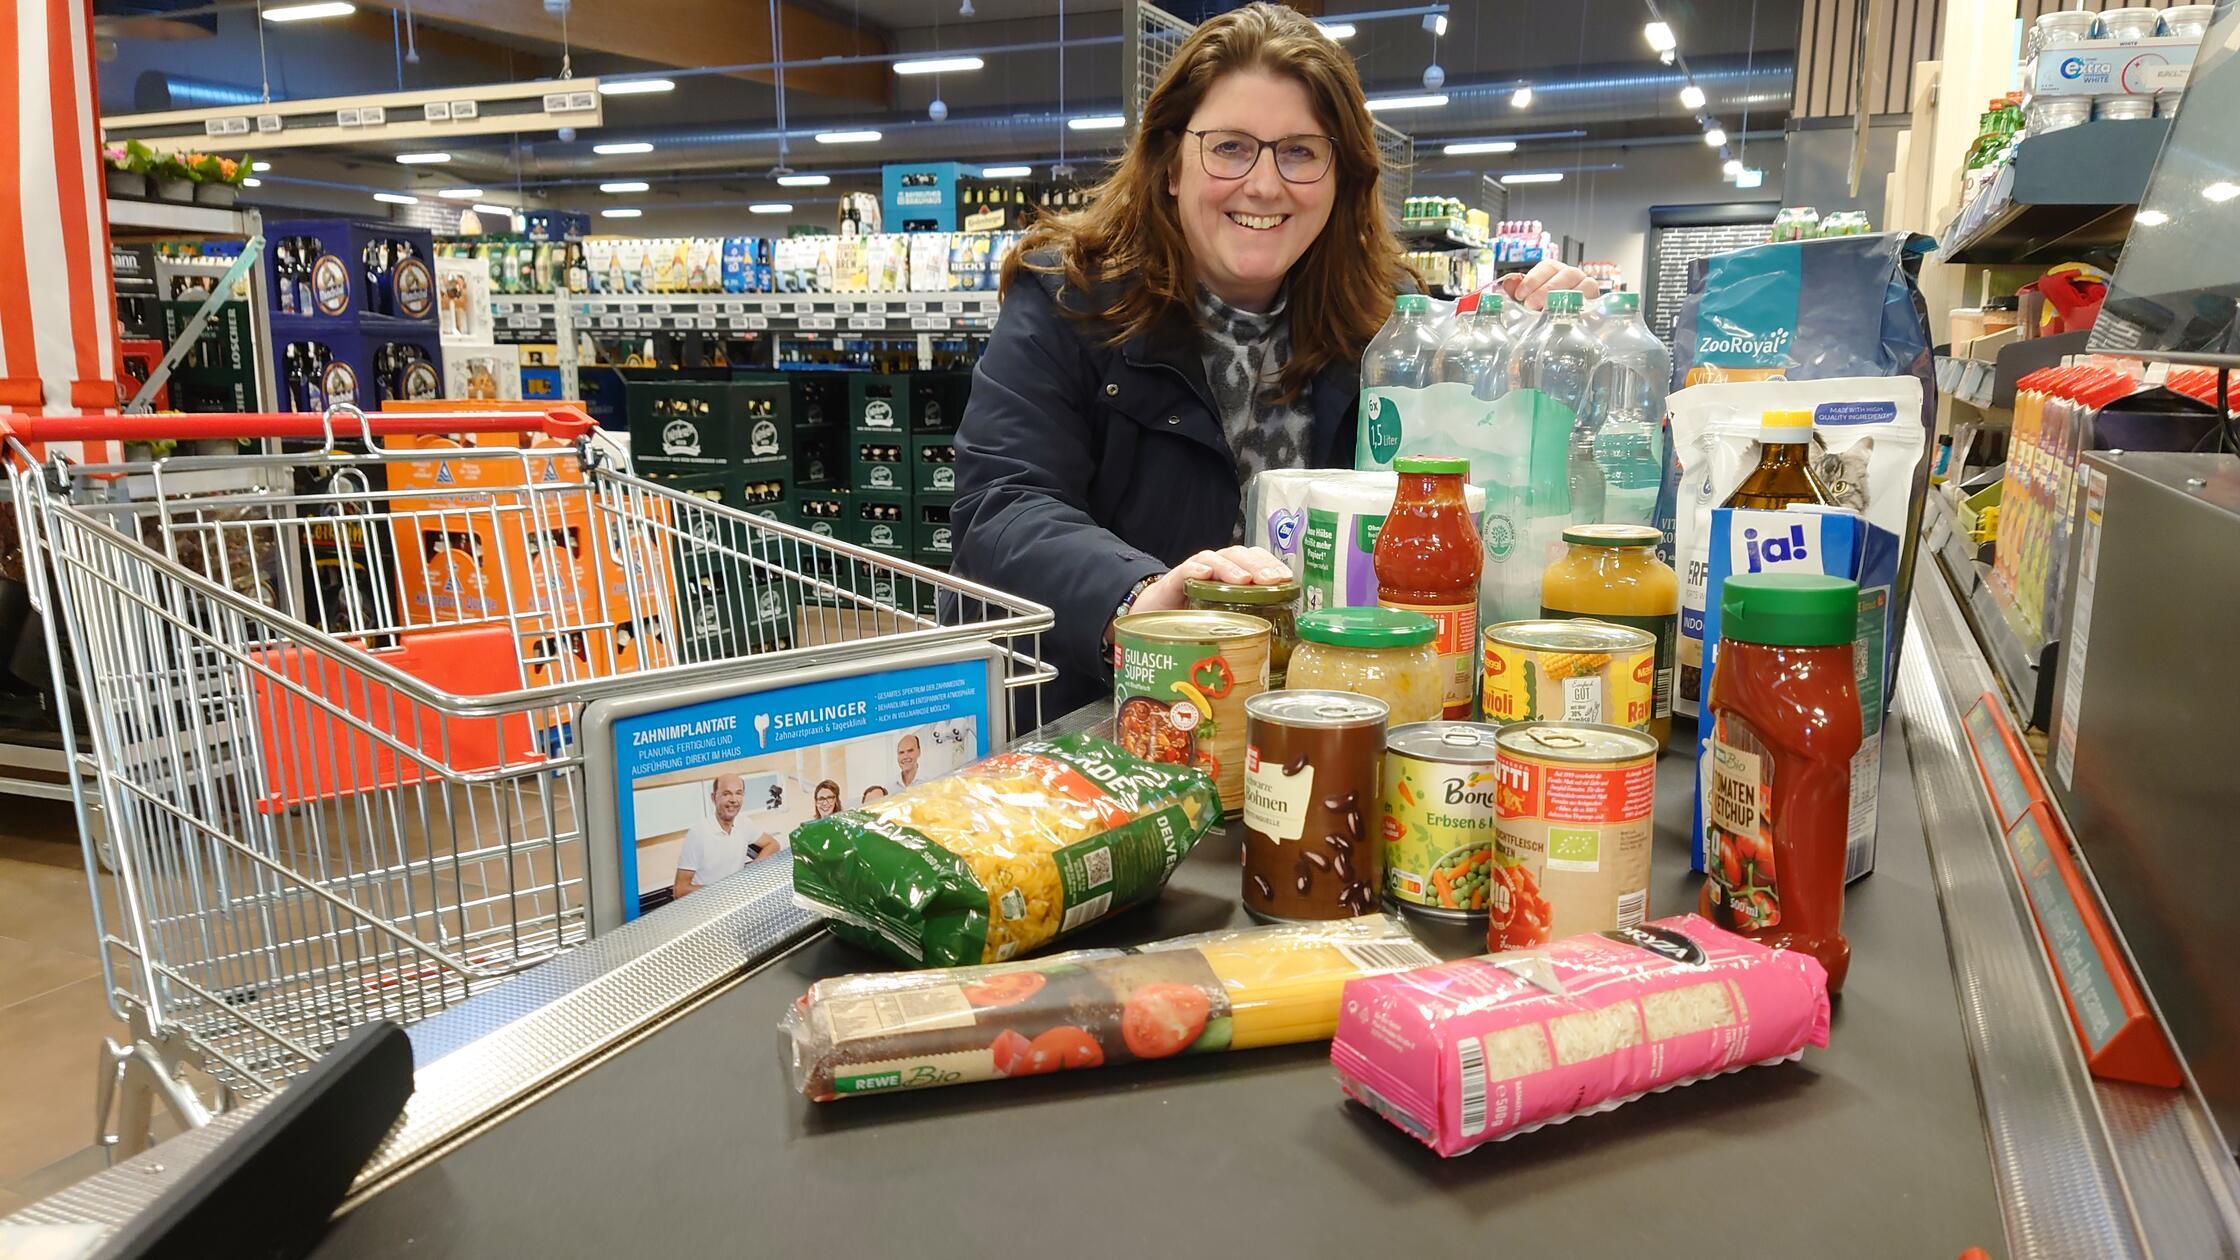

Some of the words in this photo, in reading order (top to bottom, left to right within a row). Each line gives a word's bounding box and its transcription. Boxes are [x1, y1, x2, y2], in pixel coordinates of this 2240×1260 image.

[2066, 60, 2111, 74] extra
[2083, 76, 2109, 84] WHITE
[1700, 336, 1780, 358] ZooRoyal
[1369, 400, 1379, 412] 6x
[1371, 424, 1383, 449] 1,5
[1383, 435, 1398, 447] Liter
[1744, 524, 1807, 573] ja!
[1124, 647, 1178, 671] GULASCH-
[1484, 658, 1502, 671] aggi
[1124, 663, 1155, 684] SUPPE
[1574, 688, 1591, 701] GUT
[774, 700, 867, 730] SEMLINGER
[632, 715, 737, 746] ZAHNIMPLANTATE
[775, 724, 824, 742] Zahnarztpraxis
[825, 723, 830, 733] &
[832, 716, 868, 732] Tagesklinik
[676, 737, 717, 753] FERTIGUNG
[717, 734, 733, 746] UND
[631, 758, 683, 776] AUSFÜHRUNG
[685, 752, 711, 765] DIREKT
[711, 750, 721, 760] IM
[721, 746, 742, 759] HAUS
[1726, 751, 1746, 772] Bio
[1426, 811, 1476, 829] Erbsen
[1478, 817, 1487, 830] &
[1729, 897, 1745, 912] 500
[855, 1075, 900, 1090] REWE
[903, 1065, 961, 1088] Bio
